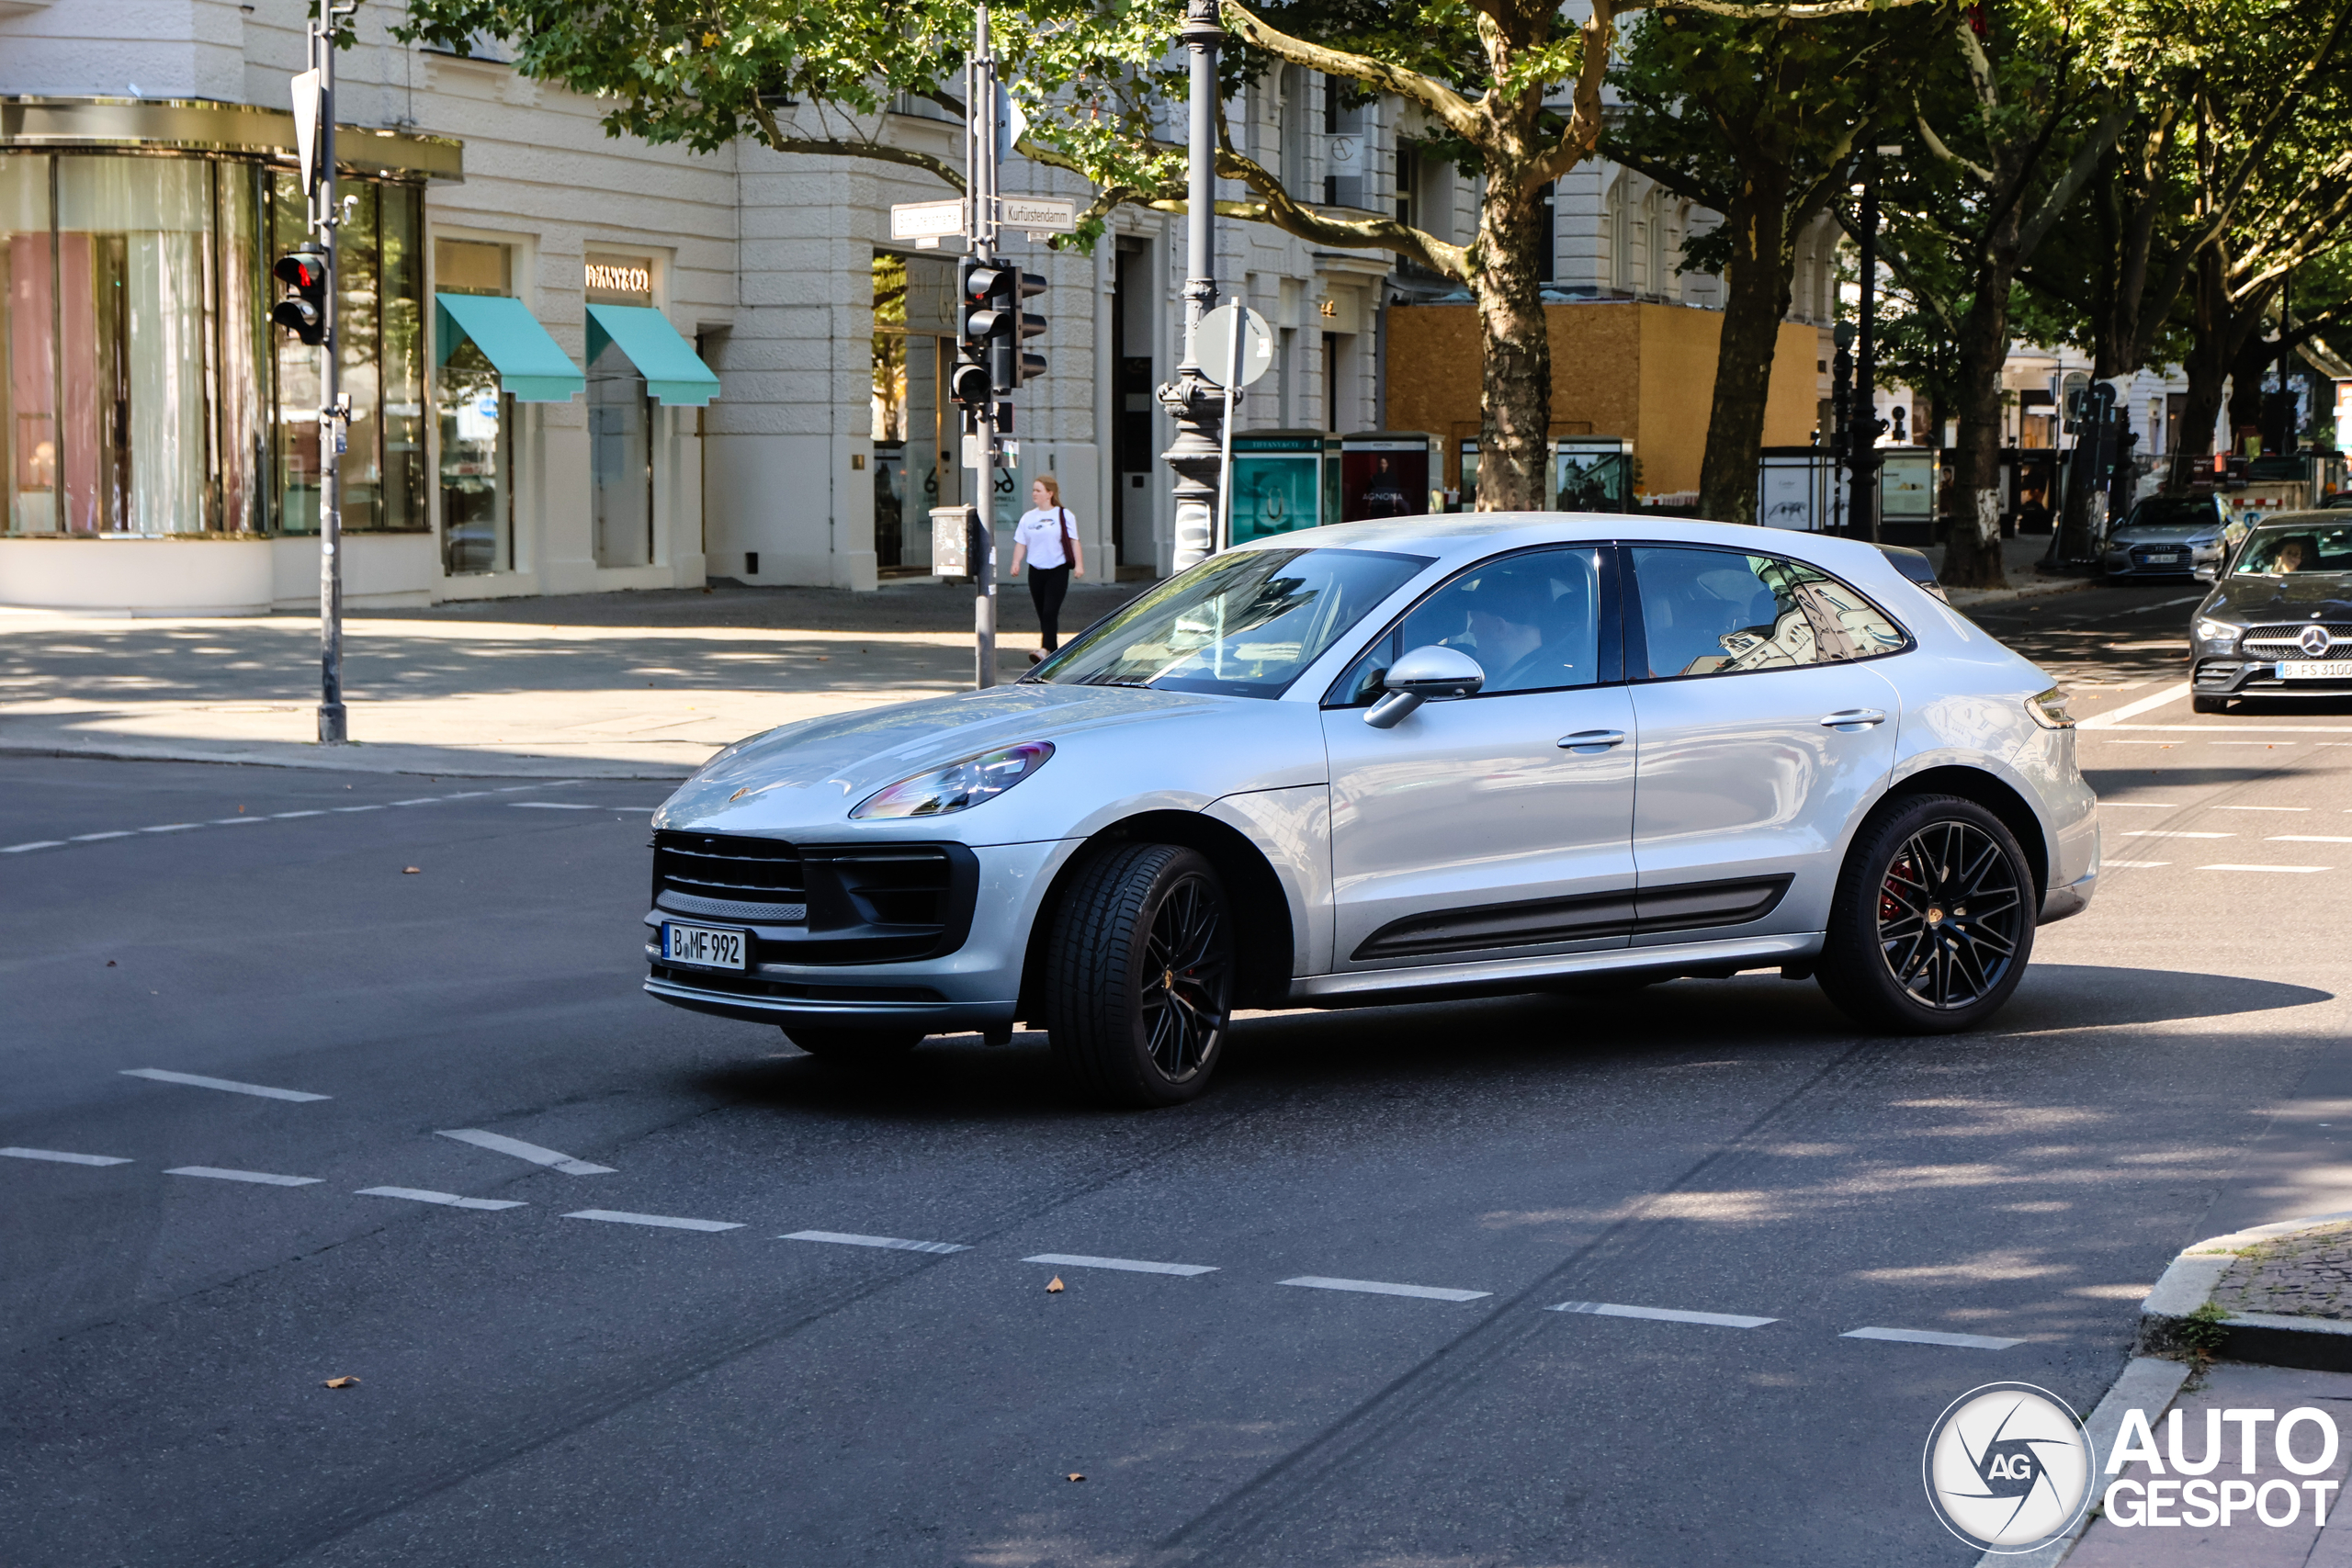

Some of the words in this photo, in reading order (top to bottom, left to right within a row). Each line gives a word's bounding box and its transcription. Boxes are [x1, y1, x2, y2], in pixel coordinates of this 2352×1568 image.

[1008, 205, 1068, 223] Kurfürstendamm
[1362, 492, 1403, 501] AGNONA
[2284, 664, 2293, 676] B
[2301, 664, 2317, 676] FS
[2321, 663, 2352, 676] 3100
[674, 929, 683, 956] B
[690, 931, 708, 959] MF
[711, 933, 740, 964] 992
